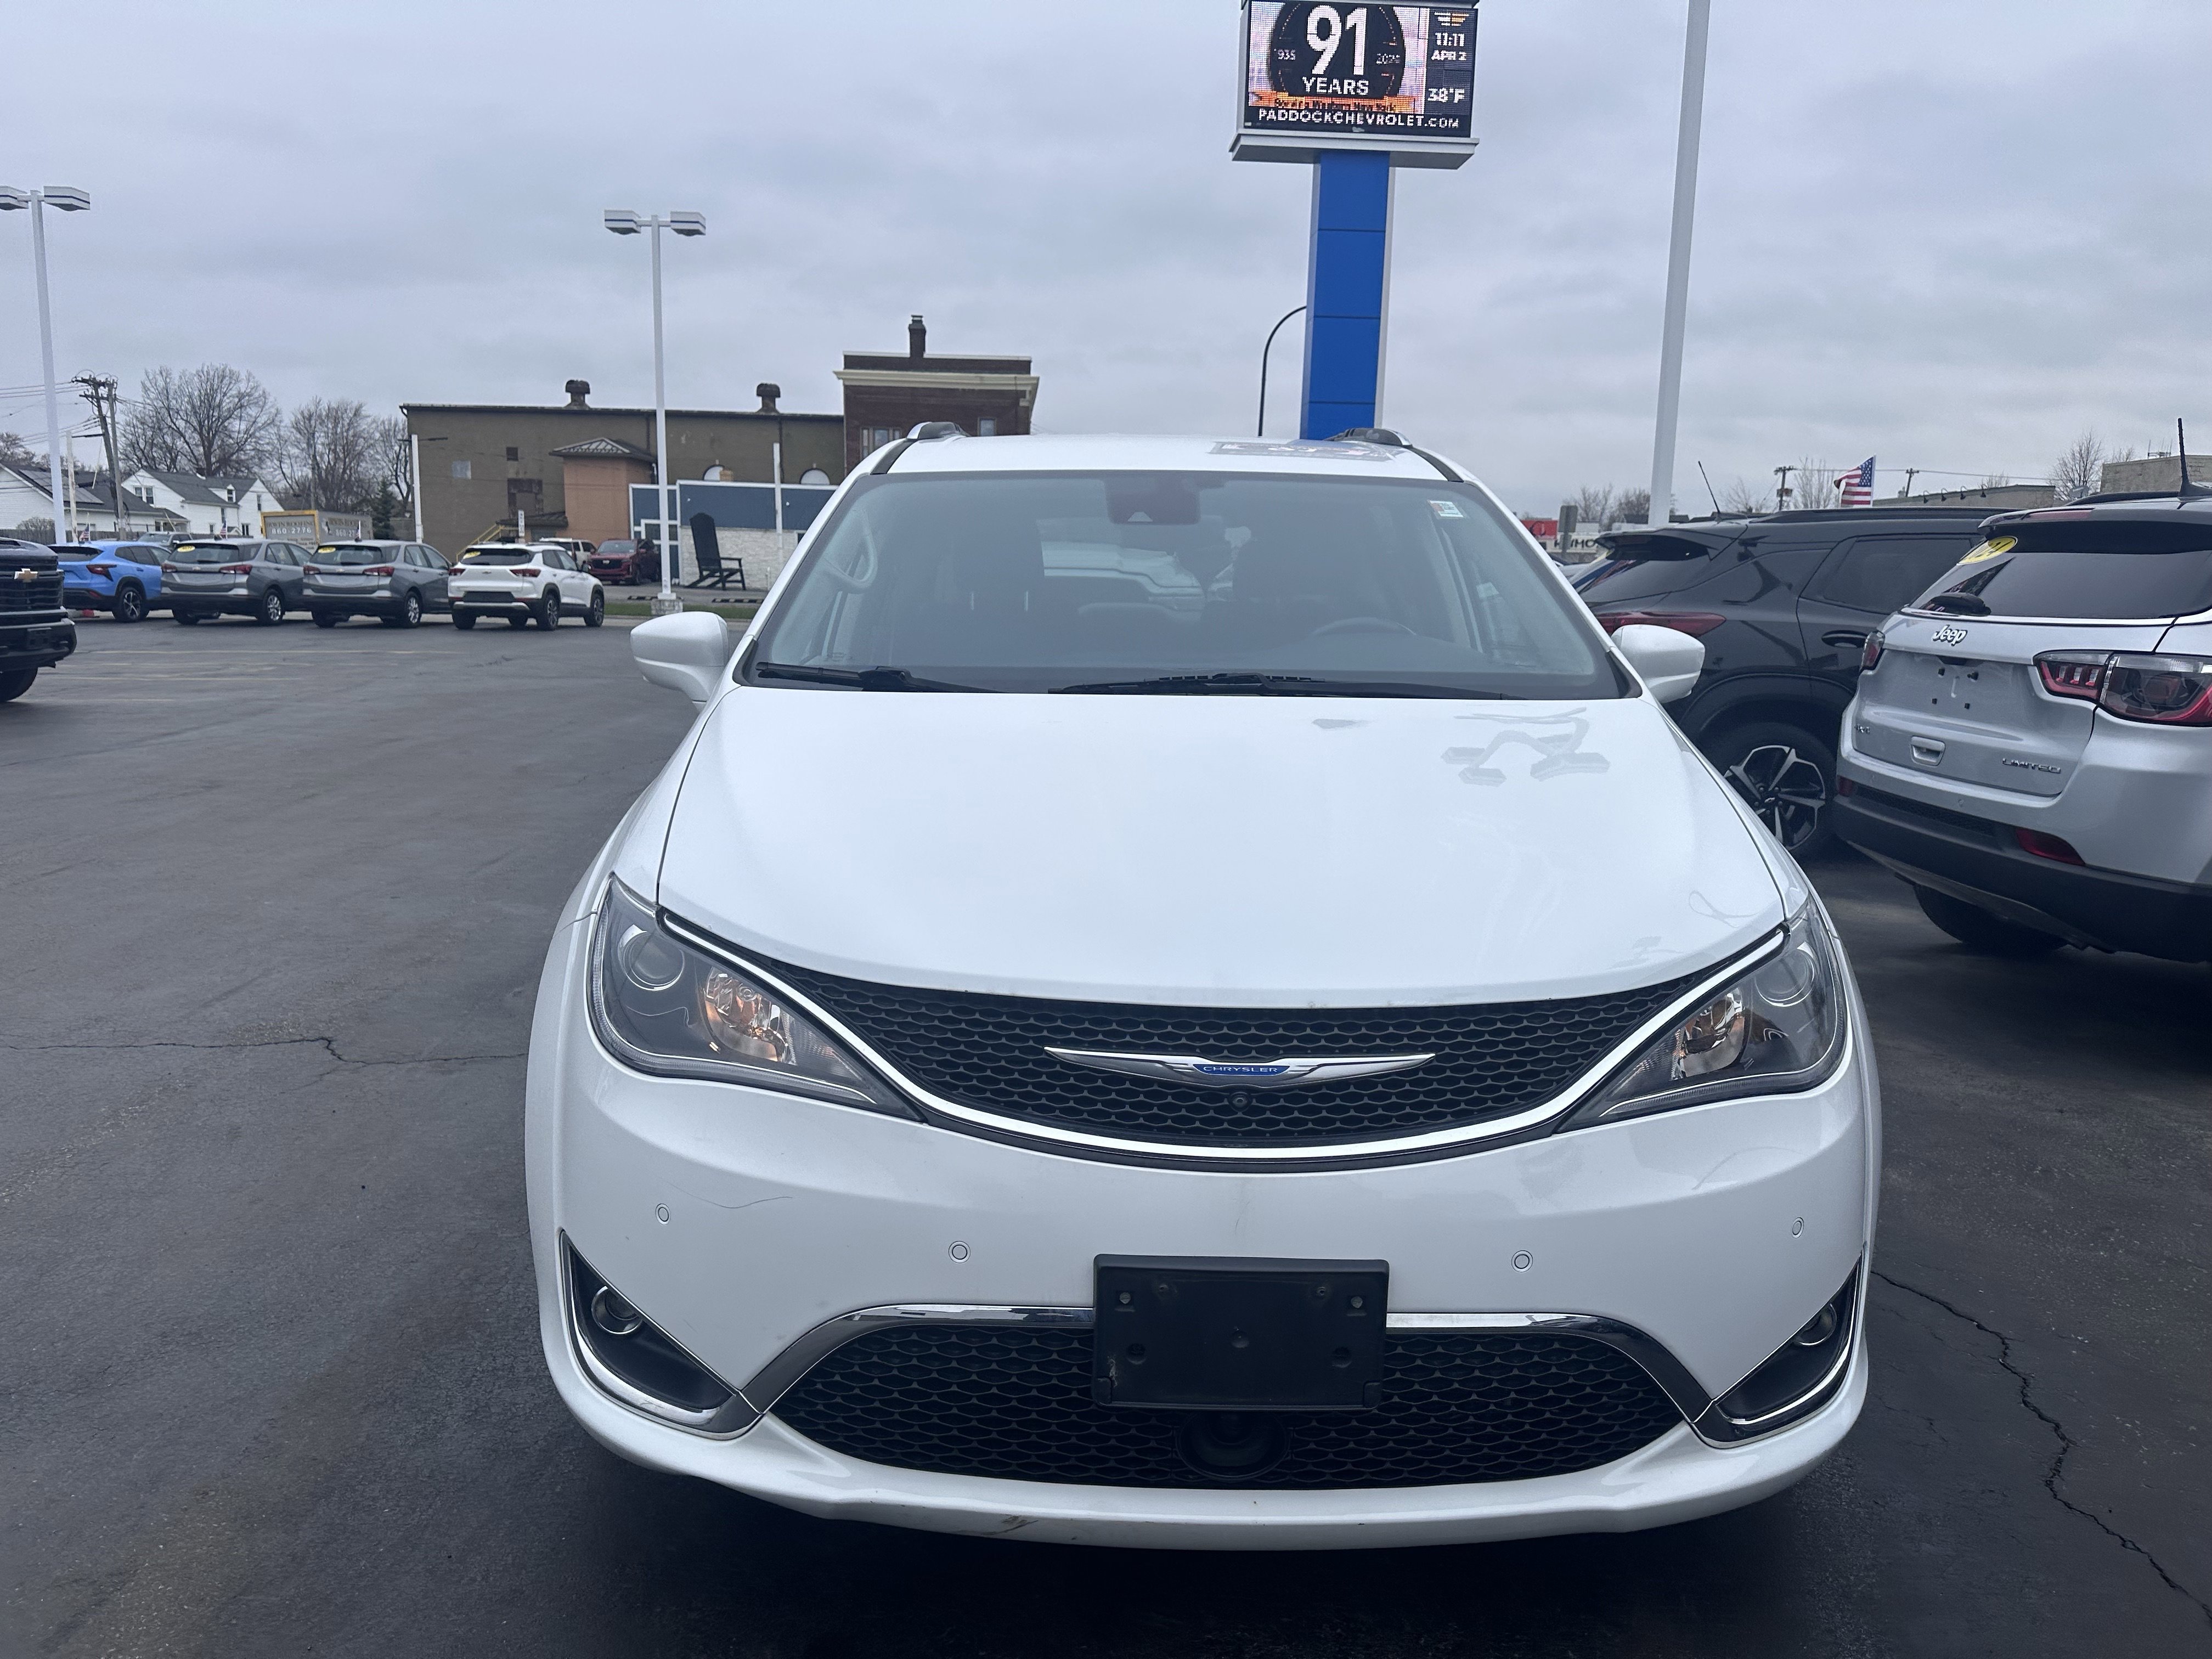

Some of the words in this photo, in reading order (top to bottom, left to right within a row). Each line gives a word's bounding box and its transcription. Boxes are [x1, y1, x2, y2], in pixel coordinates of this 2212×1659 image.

[1307, 4, 1367, 75] 91
[1435, 32, 1464, 47] 11:11
[1302, 76, 1369, 95] YEARS
[1259, 109, 1459, 128] PADDOCKCHEVROLET.COM
[1932, 624, 1968, 646] Jeep
[2002, 758, 2061, 774] LIMITED
